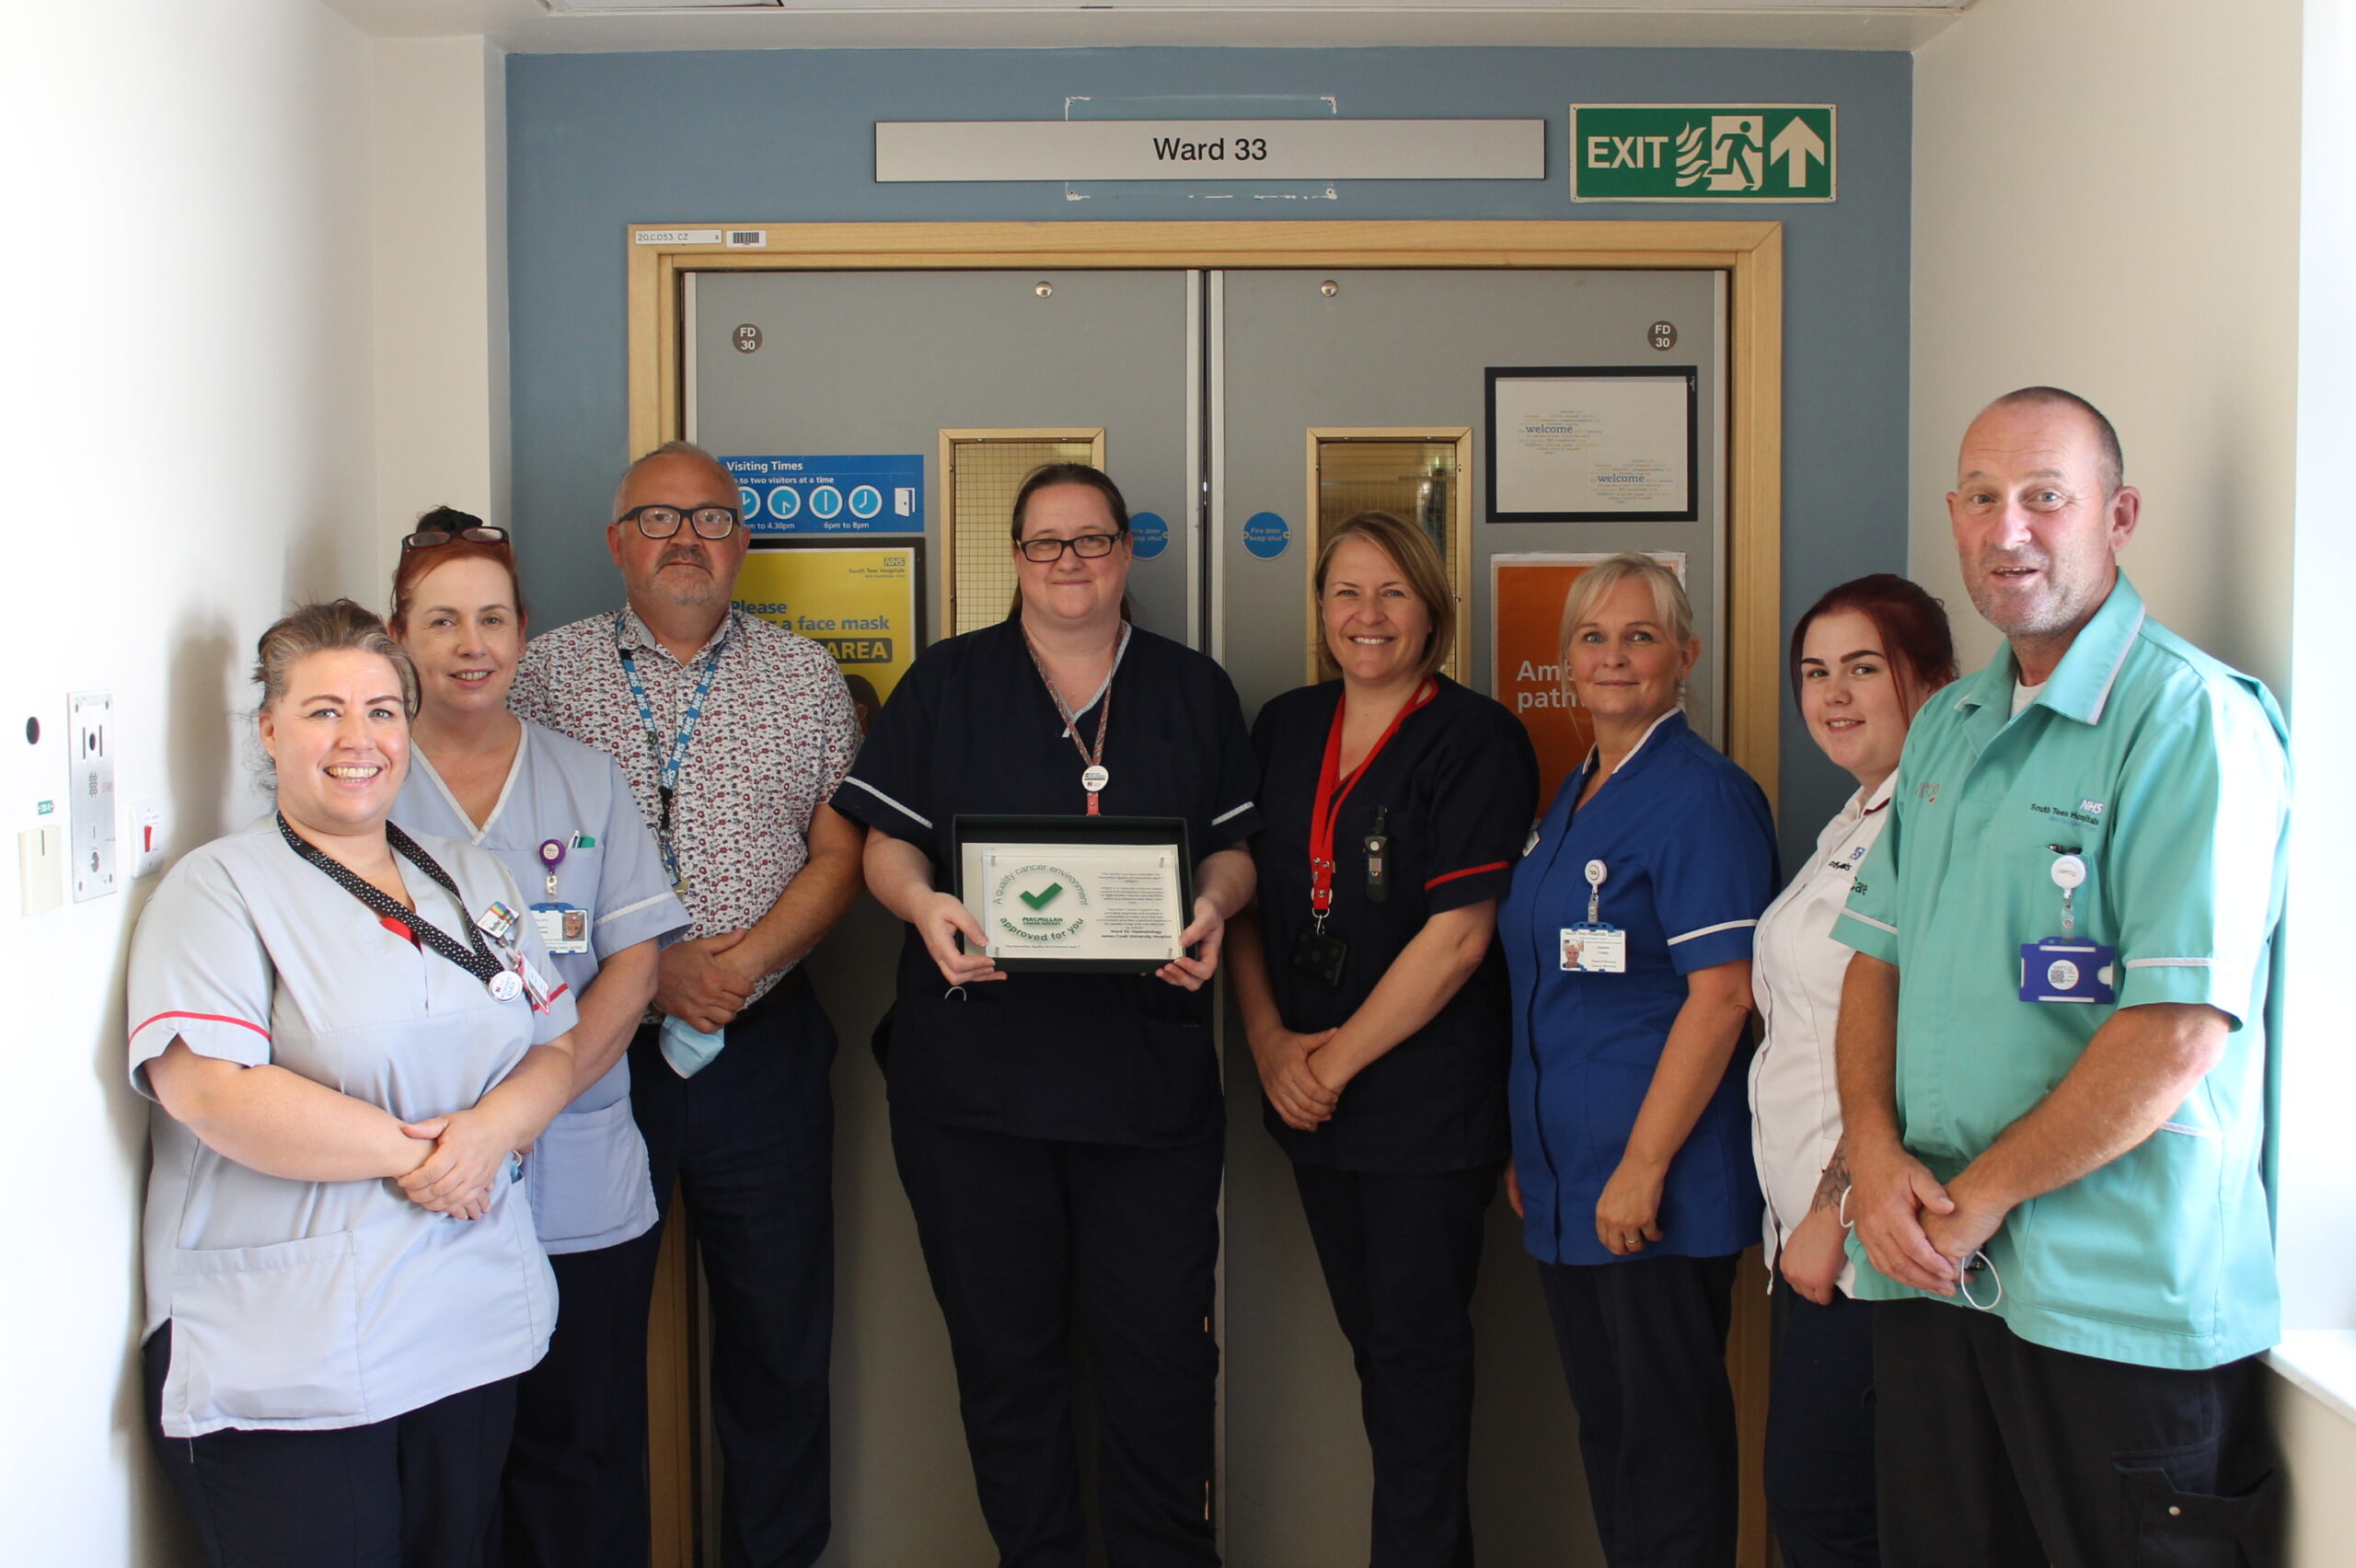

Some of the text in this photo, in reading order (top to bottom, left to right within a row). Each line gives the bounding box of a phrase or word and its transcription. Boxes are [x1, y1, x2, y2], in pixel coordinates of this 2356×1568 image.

[1152, 137, 1267, 161] Ward 33
[1587, 136, 1669, 168] EXIT
[740, 327, 756, 338] FD
[1655, 324, 1671, 335] FD
[740, 340, 756, 351] 30
[1655, 337, 1670, 348] 30
[1525, 423, 1574, 434] welcome
[726, 461, 803, 474] Visiting Times
[739, 477, 749, 485] to
[750, 477, 768, 485] two
[768, 476, 798, 484] visitors
[815, 476, 835, 484] time
[1597, 473, 1646, 483] welcome
[767, 522, 795, 531] 4.30pm
[824, 522, 840, 531] 6pm
[852, 522, 870, 530] 8pm
[884, 558, 905, 567] NHS
[731, 599, 788, 615] Please
[797, 616, 836, 631] face
[841, 615, 890, 630] mask
[826, 641, 889, 660] AREA
[692, 692, 704, 710] NHS
[682, 716, 695, 736] NHS
[672, 743, 686, 762] NHS
[2030, 803, 2050, 813] South
[2052, 807, 2069, 817] Tees
[2080, 799, 2104, 814] NHS
[996, 872, 1015, 896] quality
[1015, 864, 1047, 875] cancer
[1049, 866, 1088, 905] environment
[999, 917, 1048, 941] approved
[1051, 930, 1066, 940] for
[1068, 918, 1084, 934] you
